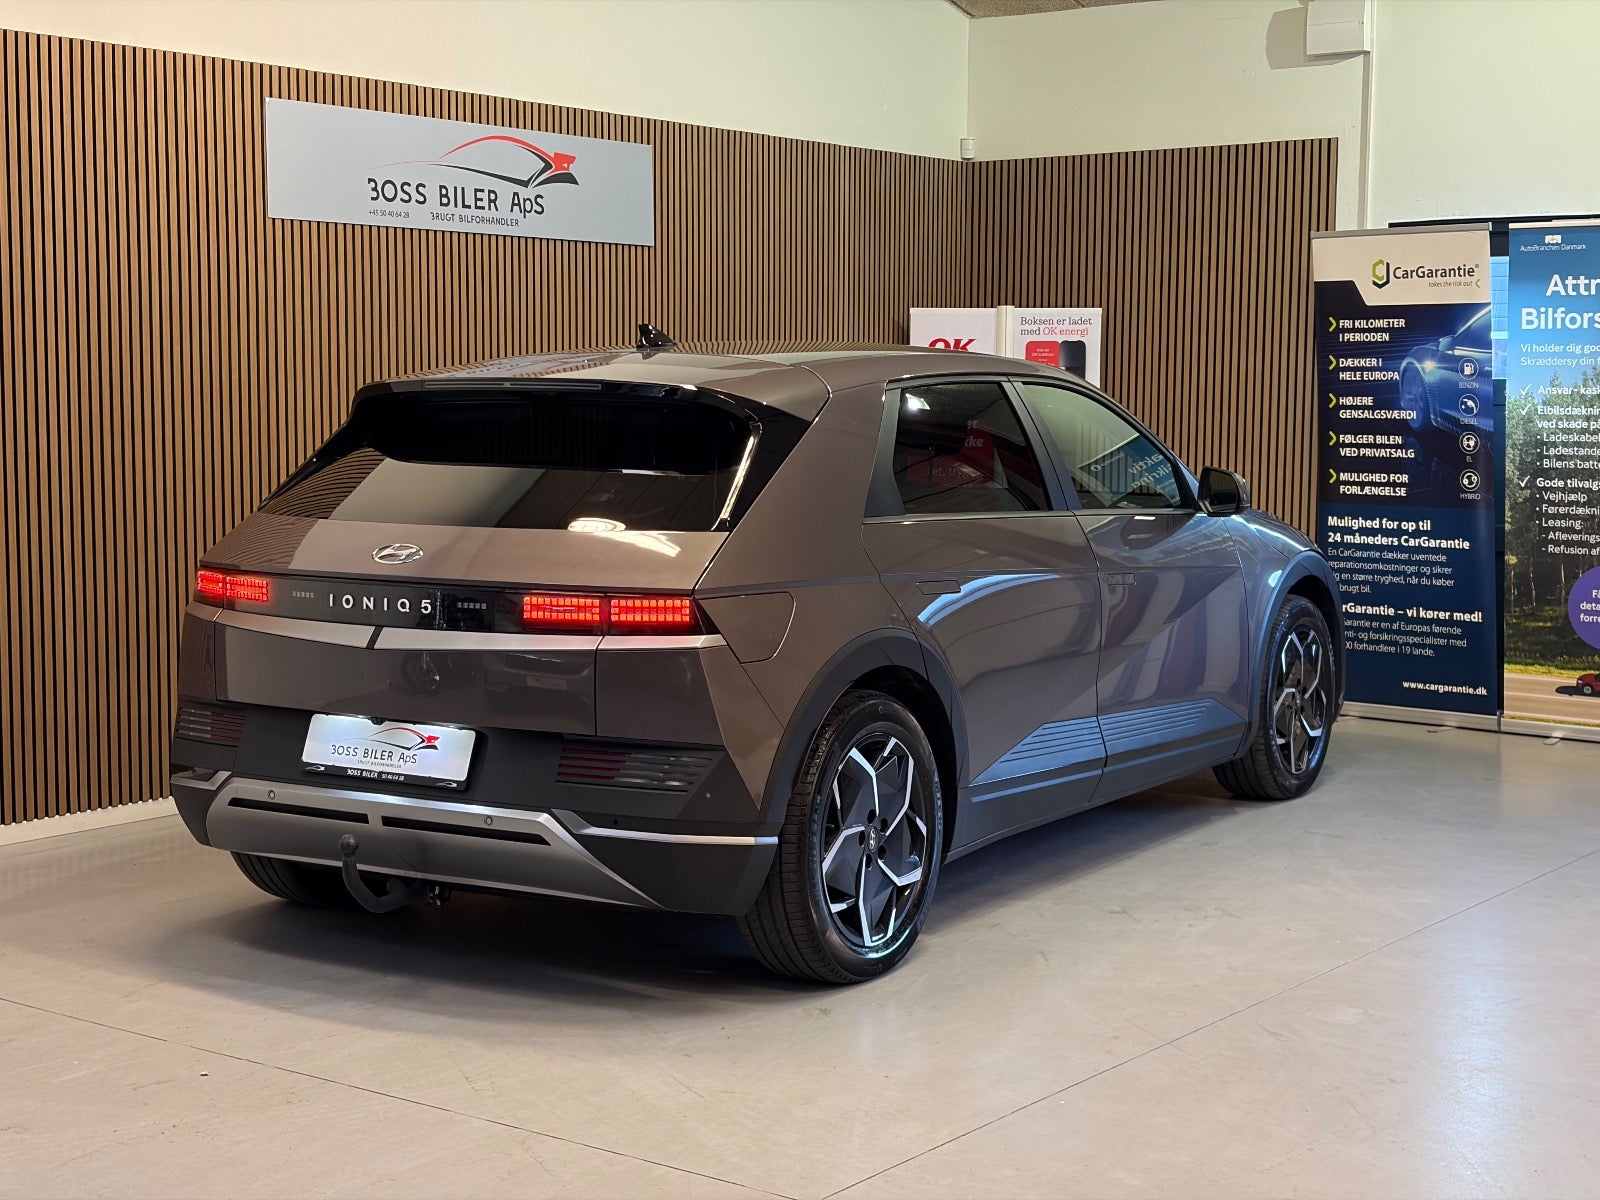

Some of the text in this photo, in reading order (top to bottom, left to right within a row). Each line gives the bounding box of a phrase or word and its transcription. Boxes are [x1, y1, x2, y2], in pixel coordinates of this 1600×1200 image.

[438, 184, 499, 212] BILER
[509, 191, 545, 218] ApS
[368, 209, 379, 217] +45
[379, 209, 387, 217] 50
[387, 210, 395, 218] 40
[402, 211, 410, 219] 28
[458, 214, 519, 228] BILFORHANDLER
[1393, 264, 1475, 279] CarGarantie
[1545, 274, 1600, 296] Attr
[1020, 316, 1054, 326] Boksen
[1068, 316, 1093, 326] ladet
[1339, 318, 1406, 329] FRI KILOMETER
[1020, 327, 1089, 337] med OK energi
[1339, 333, 1390, 342] I PERIODEN
[1520, 343, 1531, 353] Vi
[1532, 343, 1564, 353] holder
[1566, 343, 1582, 354] dig
[1339, 358, 1378, 367] DÆKKER
[1520, 356, 1577, 368] Skræddersy
[1579, 357, 1595, 366] din
[1339, 371, 1400, 381] HELE EUROPA
[1459, 381, 1479, 389] BENZIN
[1537, 385, 1578, 395] Ansvar-
[1339, 396, 1374, 406] HØJERE
[1339, 409, 1417, 420] GENSALGSVÆRDI
[1537, 419, 1556, 429] ved
[1557, 419, 1588, 429] skade
[1339, 434, 1402, 445] FØLGER BILEN
[1543, 432, 1600, 442] Ladeskabel
[1339, 448, 1415, 459] VED PRIVATSALG
[1466, 455, 1473, 463] EL
[1543, 458, 1575, 468] Bilens
[1339, 472, 1409, 483] MULIGHED FOR
[1536, 477, 1565, 487] Gode
[1339, 485, 1407, 496] FORLÆNGELSE
[1542, 490, 1588, 503] Vejhjælp
[1328, 515, 1431, 532] Mulighed for op til
[1542, 517, 1584, 530] Leasing:
[1328, 532, 1470, 549] 24 måneders CarGarantie
[1328, 547, 1447, 563] En CarGarantie dækker uventede
[1547, 544, 1589, 555] Refusion
[1420, 566, 1431, 575] og
[1432, 565, 1453, 575] sikrer
[1352, 573, 1373, 582] større
[1374, 574, 1405, 584] tryghed,
[1406, 576, 1419, 585] når
[1420, 576, 1431, 585] du
[1432, 577, 1454, 587] køber
[1339, 583, 1372, 594] brugt bil.
[329, 593, 432, 614] IONIQ 5
[1342, 602, 1395, 616] rGarantie
[1406, 606, 1417, 618] vi
[1420, 606, 1450, 620] kører
[1453, 611, 1482, 623] med!
[1392, 621, 1400, 630] af
[1400, 622, 1431, 633] Europas
[1432, 624, 1462, 635] førende
[1358, 632, 1368, 641] og
[1370, 631, 1447, 646] forsikringsspecialister
[1450, 637, 1467, 647] med
[1354, 641, 1396, 653] forhandlere
[1402, 645, 1411, 655] 19
[1412, 646, 1435, 657] lande.
[1402, 680, 1488, 696] www.cargarantie.dk
[363, 748, 394, 761] BILER
[397, 752, 418, 765] ApS
[362, 770, 378, 779] BILER
